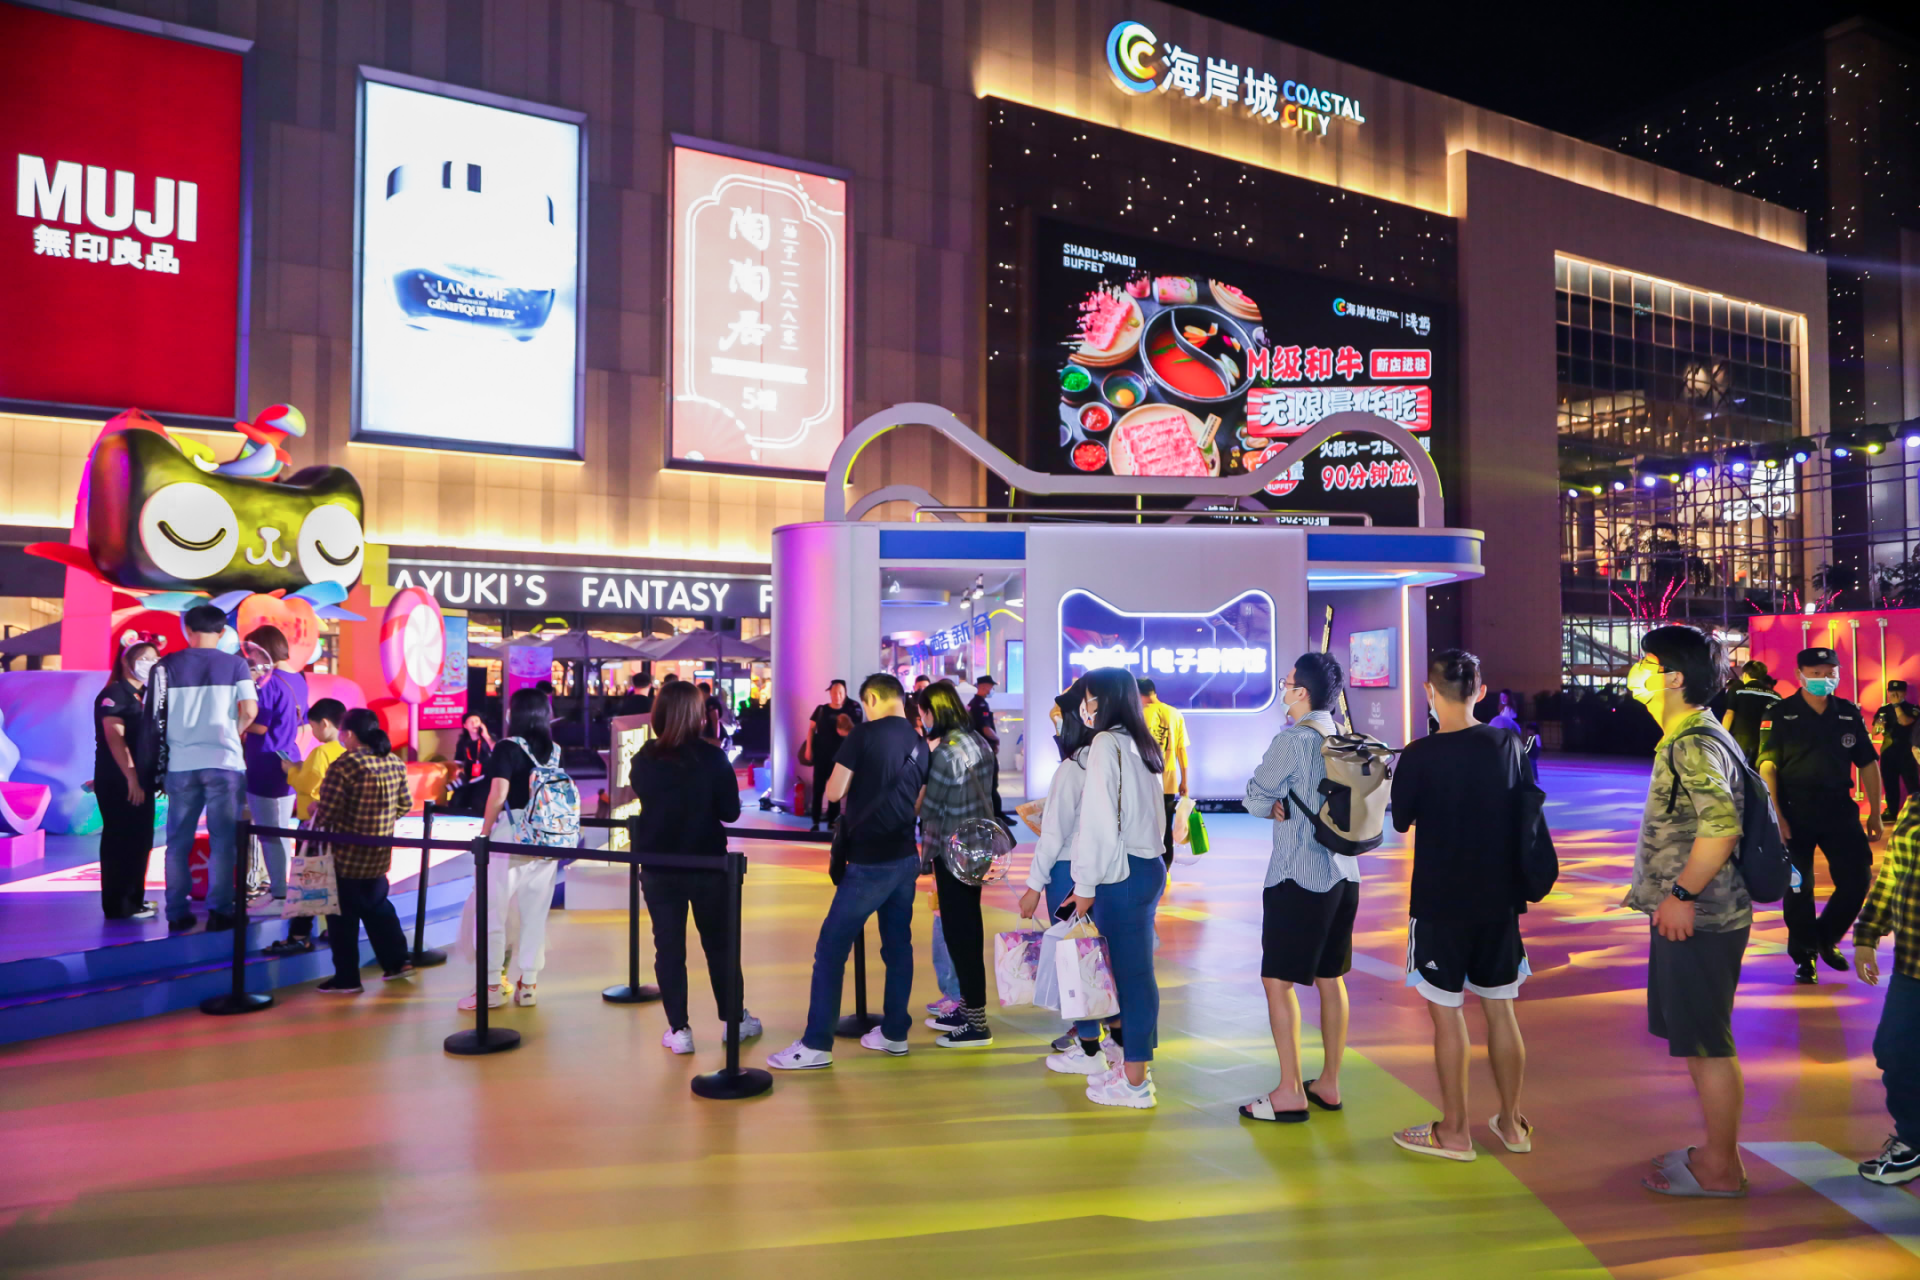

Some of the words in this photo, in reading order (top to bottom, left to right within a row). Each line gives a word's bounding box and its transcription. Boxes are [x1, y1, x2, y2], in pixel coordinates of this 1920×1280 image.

[1161, 42, 1279, 121] 海岸城
[1282, 79, 1366, 123] COASTAL
[1282, 104, 1331, 136] CITY
[16, 153, 198, 242] MUJI
[33, 223, 180, 275] 無印良品
[1063, 242, 1137, 268] SHABU-SHABU
[1063, 255, 1105, 274] BUFFET
[1346, 302, 1376, 321] 海岸城
[1376, 307, 1399, 319] COASTAL
[1376, 315, 1390, 323] CITY
[1246, 345, 1364, 382] M级和牛
[1376, 356, 1427, 373] 新店进驻
[581, 576, 731, 613] FANTASY
